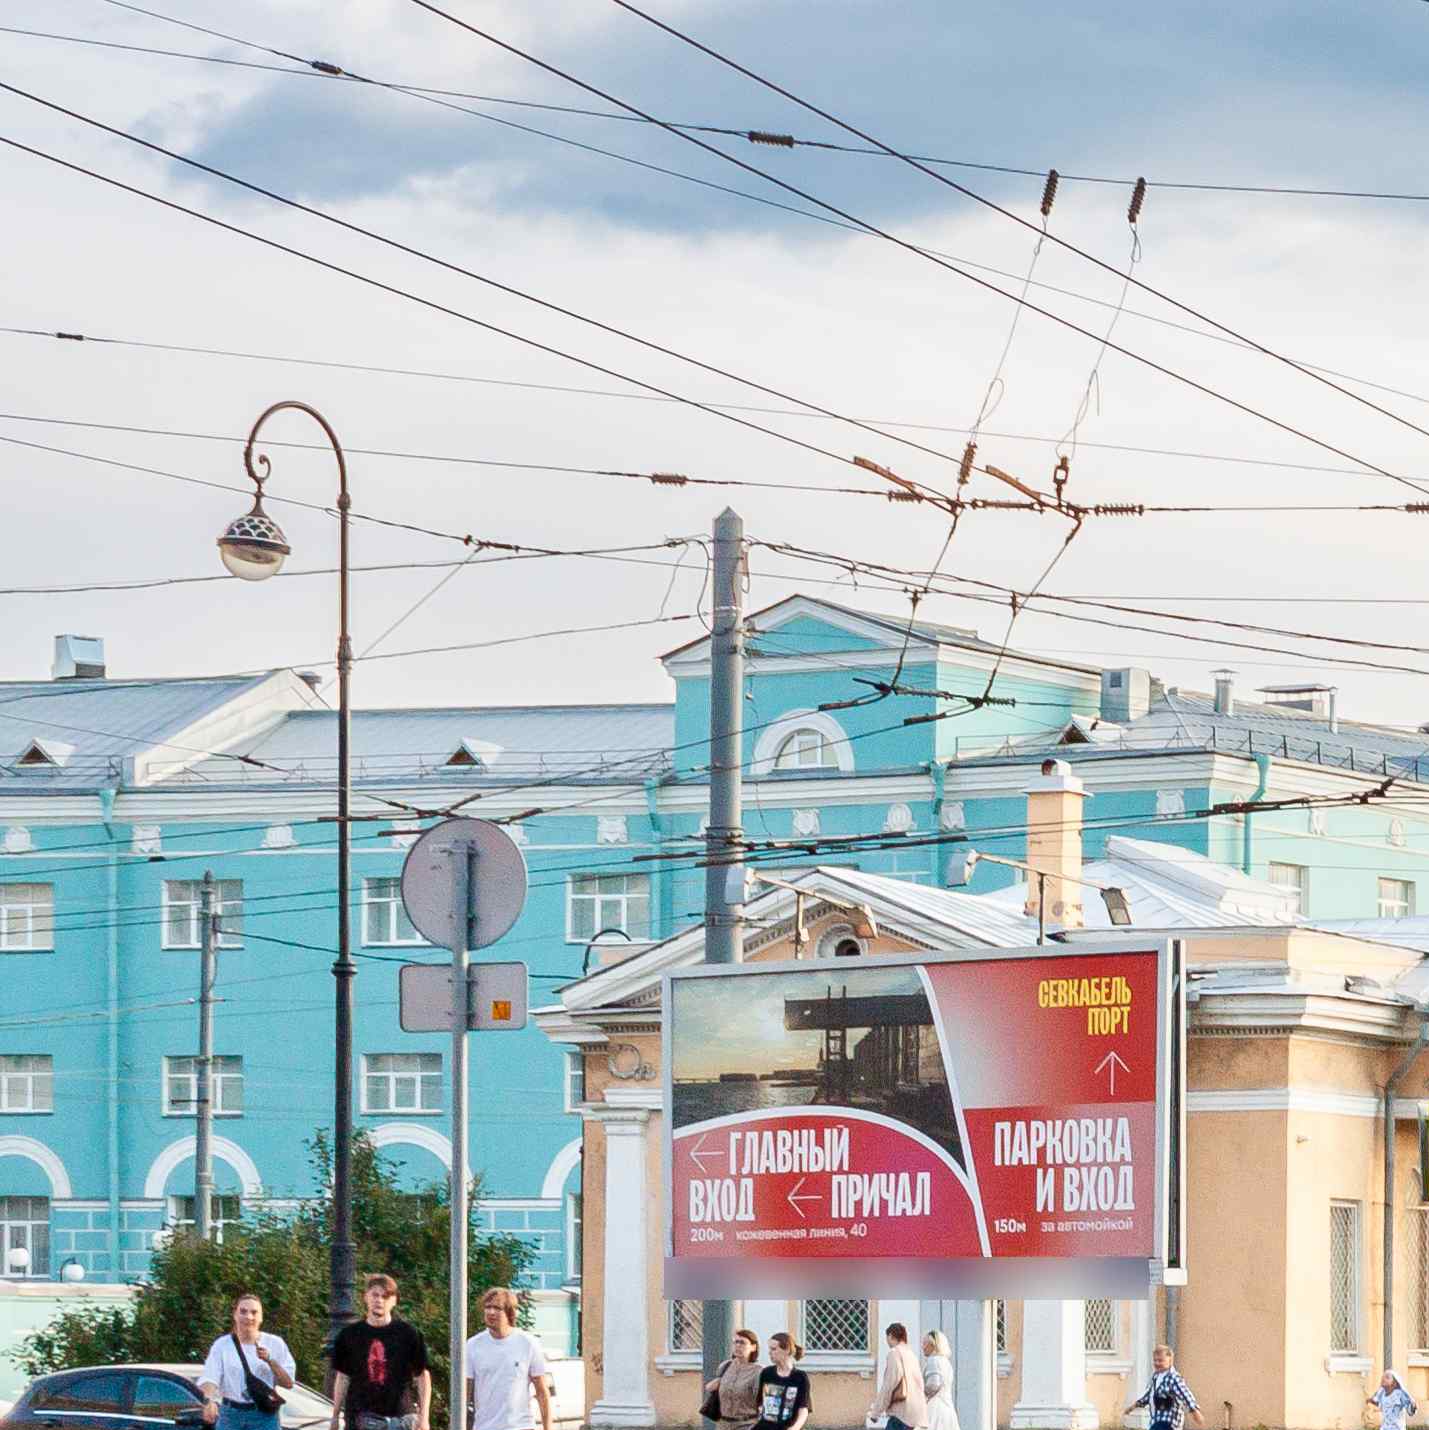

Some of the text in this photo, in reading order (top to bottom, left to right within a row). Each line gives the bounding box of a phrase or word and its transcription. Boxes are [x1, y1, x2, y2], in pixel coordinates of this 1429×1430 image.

[1038, 977, 1132, 1008] СЕВКАБЕЛЬ
[1087, 1006, 1131, 1035] ПОРТ
[729, 1125, 850, 1175] ГЛАВНЫЙ
[994, 1117, 1132, 1166] ПАРКОВКА
[689, 1178, 756, 1222] ВХОД
[831, 1172, 931, 1218] ПРИЧАЛ
[1036, 1165, 1135, 1212] И ВХОД
[690, 1228, 723, 1242] 200м
[850, 1223, 868, 1237] 40
[994, 1217, 1133, 1233] 150м за автомойкой
